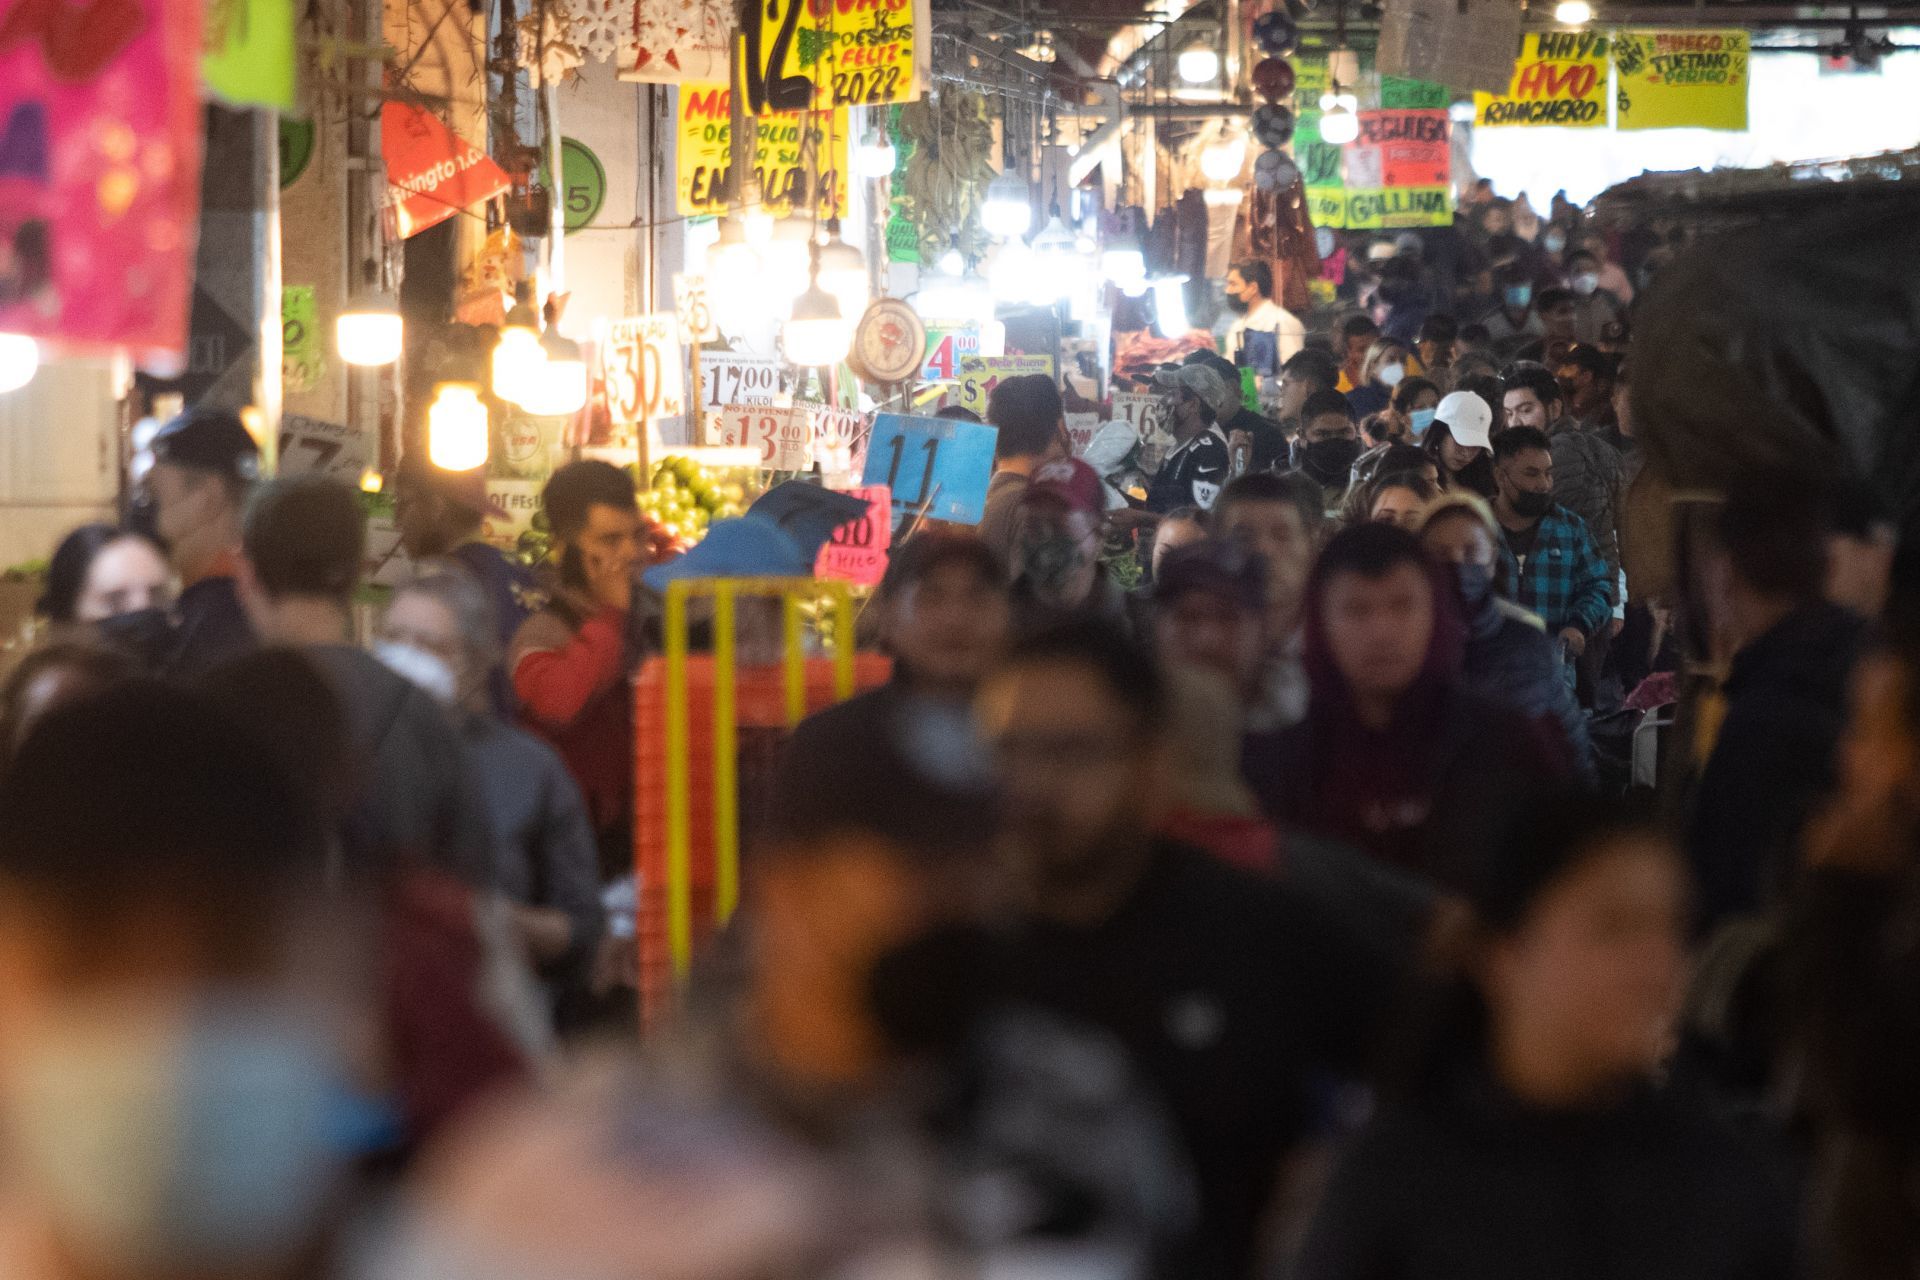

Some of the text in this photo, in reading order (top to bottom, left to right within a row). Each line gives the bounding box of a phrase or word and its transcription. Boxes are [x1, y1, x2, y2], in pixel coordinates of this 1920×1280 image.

[841, 43, 899, 67] FELIZ
[1538, 31, 1595, 58] HAY
[832, 66, 900, 105] 2022
[1484, 98, 1598, 124] RANCHERO
[567, 186, 592, 213] 5
